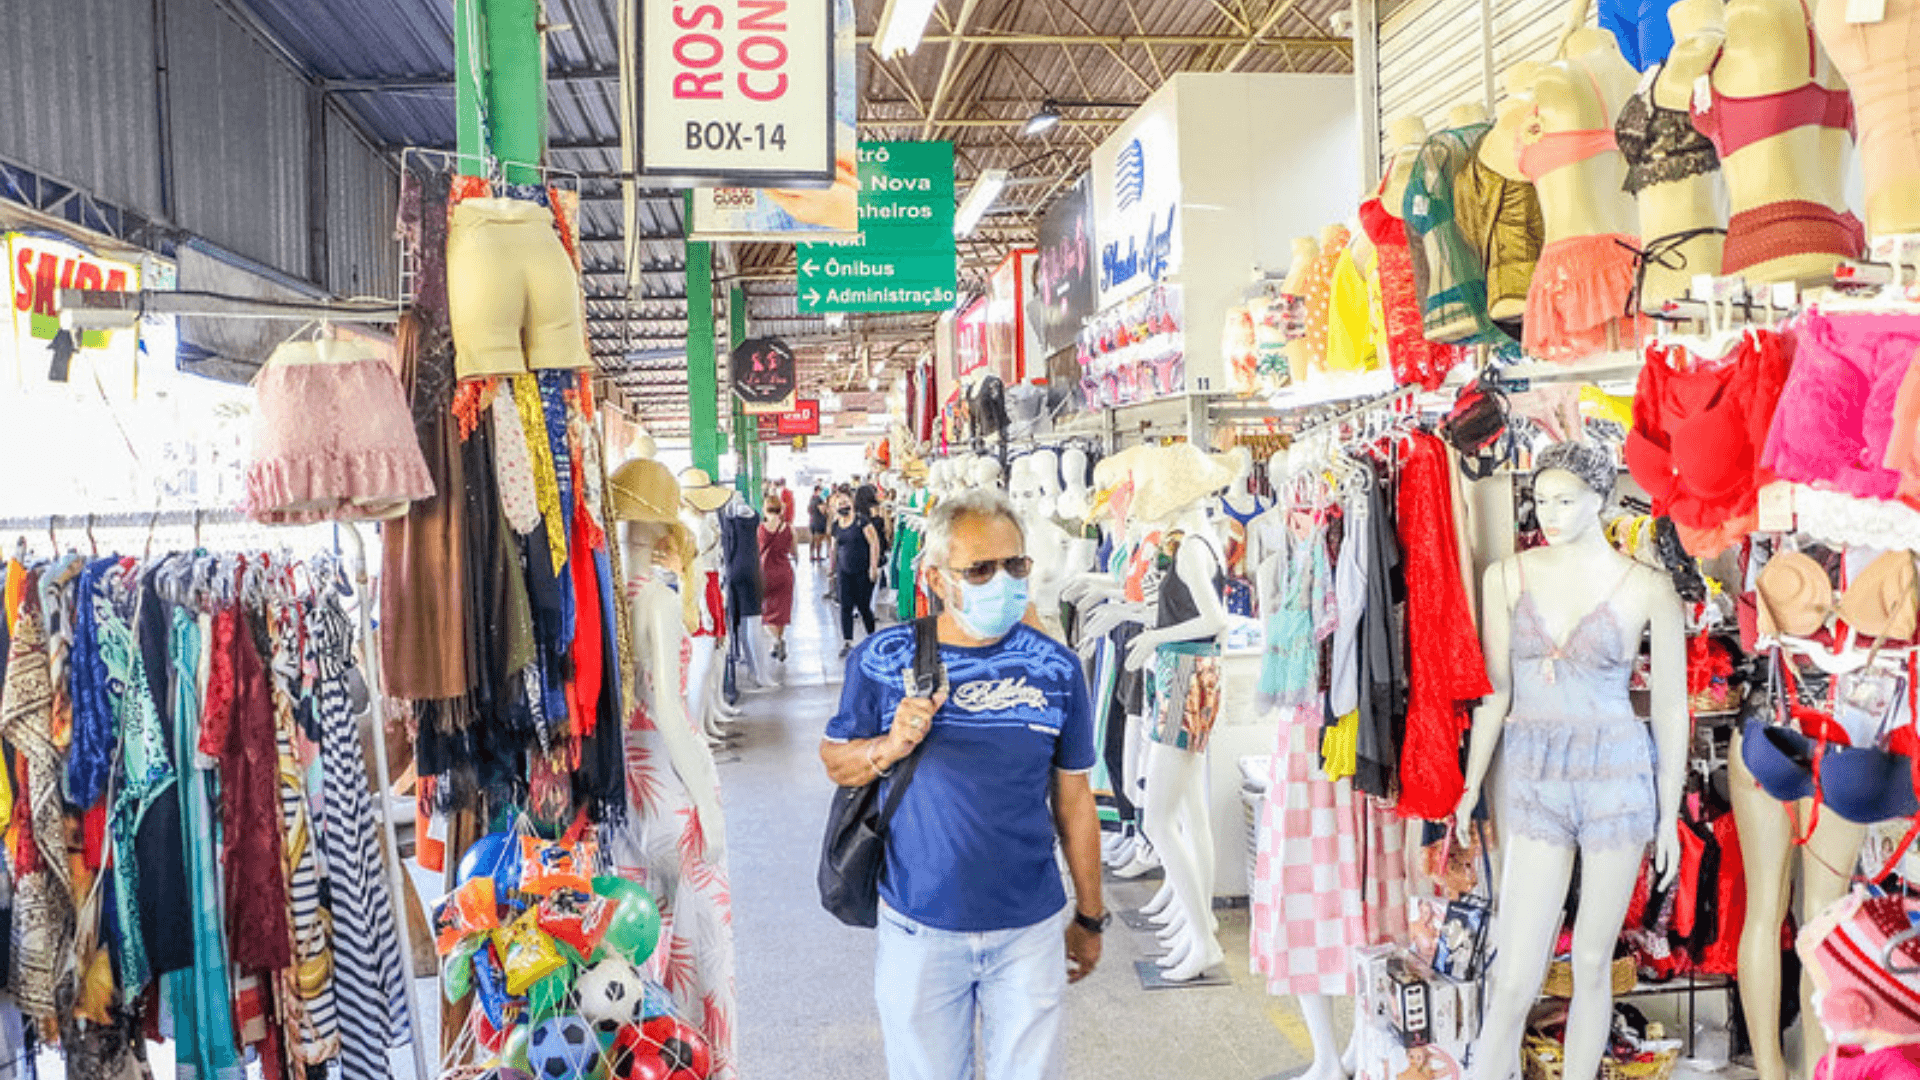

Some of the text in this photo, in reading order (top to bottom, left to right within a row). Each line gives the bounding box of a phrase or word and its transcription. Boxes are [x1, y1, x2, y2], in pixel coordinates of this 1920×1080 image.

[672, 0, 724, 100] ROS
[685, 121, 787, 152] BOX-14
[857, 146, 891, 163] trô
[871, 175, 932, 192] Nova
[857, 202, 933, 219] nheiros
[824, 257, 895, 277] Ônibus
[826, 287, 955, 306] Administração
